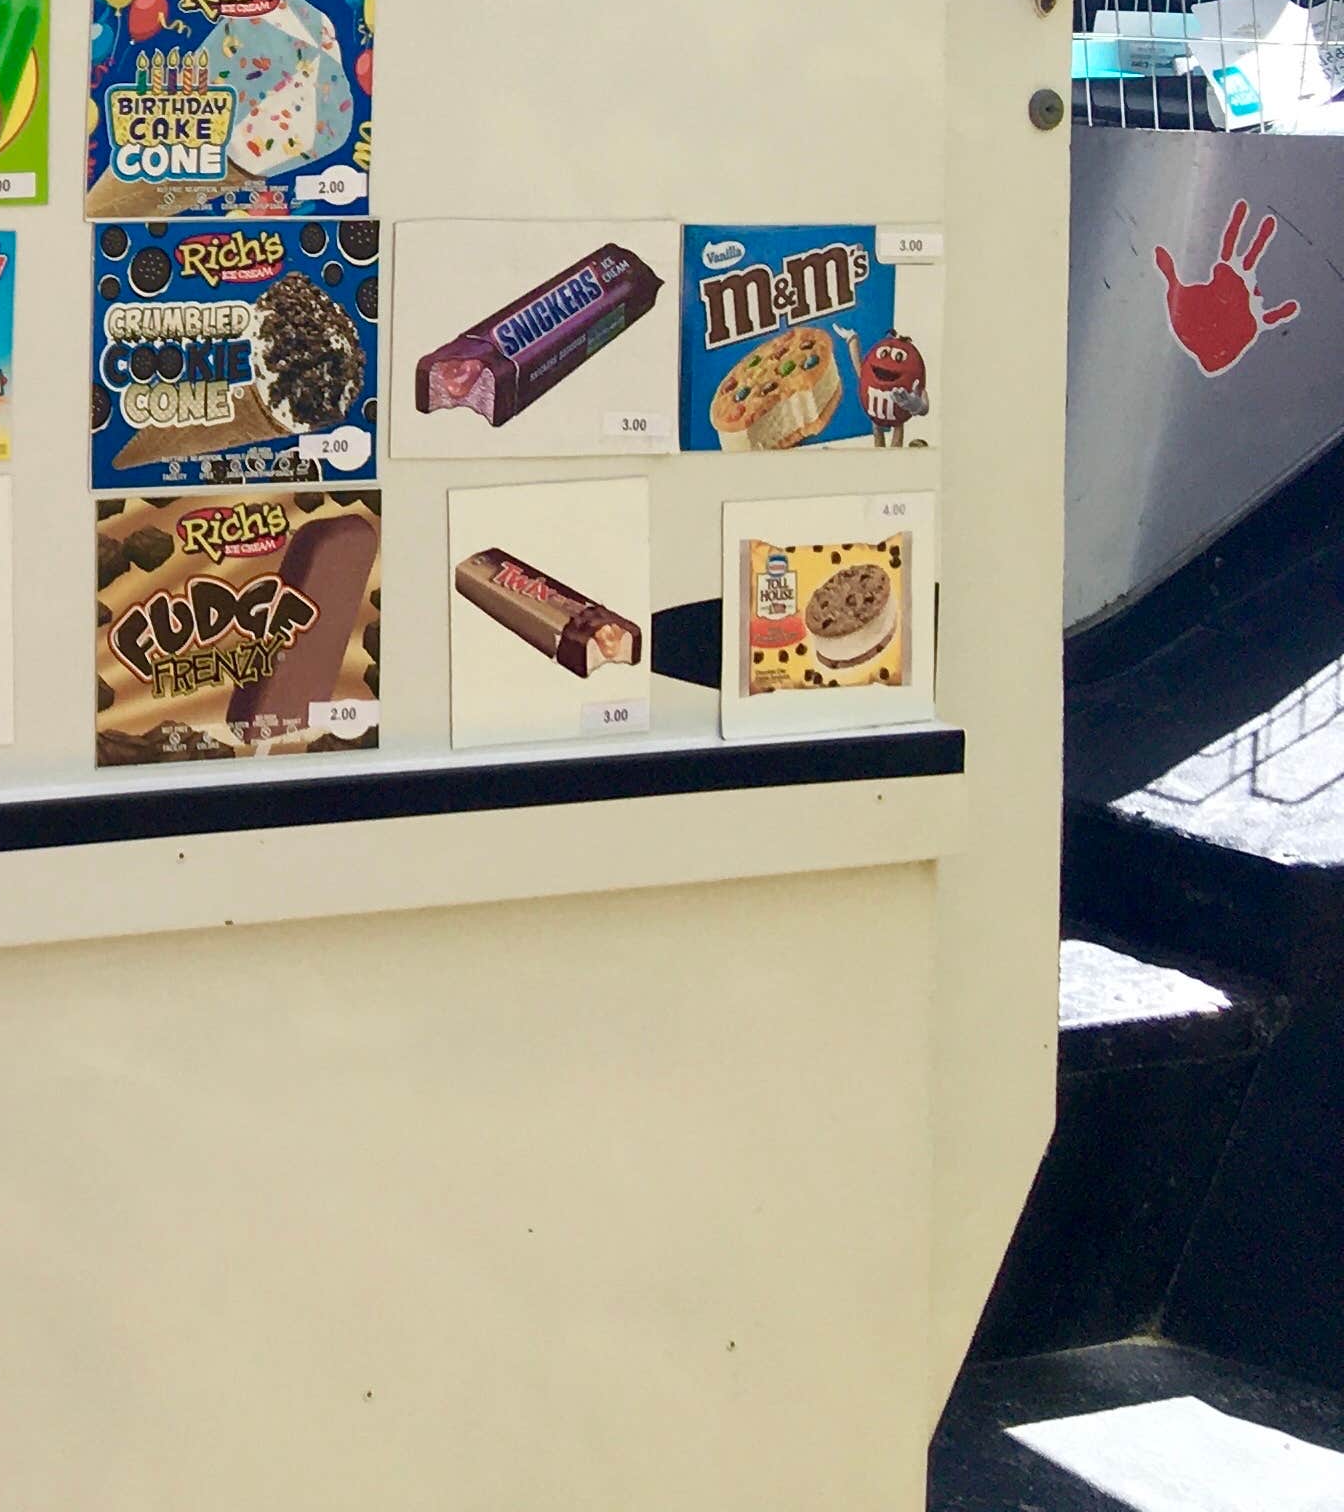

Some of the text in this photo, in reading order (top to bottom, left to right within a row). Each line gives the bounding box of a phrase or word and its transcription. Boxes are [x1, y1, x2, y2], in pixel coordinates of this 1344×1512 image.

[117, 96, 228, 116] BIRTHDAY
[128, 118, 213, 140] CAKE
[116, 143, 223, 176] CONE
[318, 179, 345, 194] 2.00
[706, 246, 743, 264] Vanilla
[899, 239, 924, 251] 3.00
[178, 230, 286, 287] Rich's
[599, 255, 616, 270] ICE
[602, 259, 631, 284] CREAM
[107, 304, 252, 340] CRUMBLED
[495, 266, 604, 358] SNICKERS
[102, 340, 252, 385] COOKIE
[123, 381, 233, 423] CONE
[622, 418, 647, 432] 3.00
[322, 439, 349, 454] 2.00
[882, 503, 907, 516] 4.00
[181, 502, 290, 565] Rich's
[765, 578, 789, 590] TOLL
[759, 589, 795, 603] HOUSE
[114, 578, 317, 678] FUDGE
[152, 634, 288, 699] FRENZY
[330, 706, 357, 721] 2.00
[603, 708, 629, 723] 3.00
